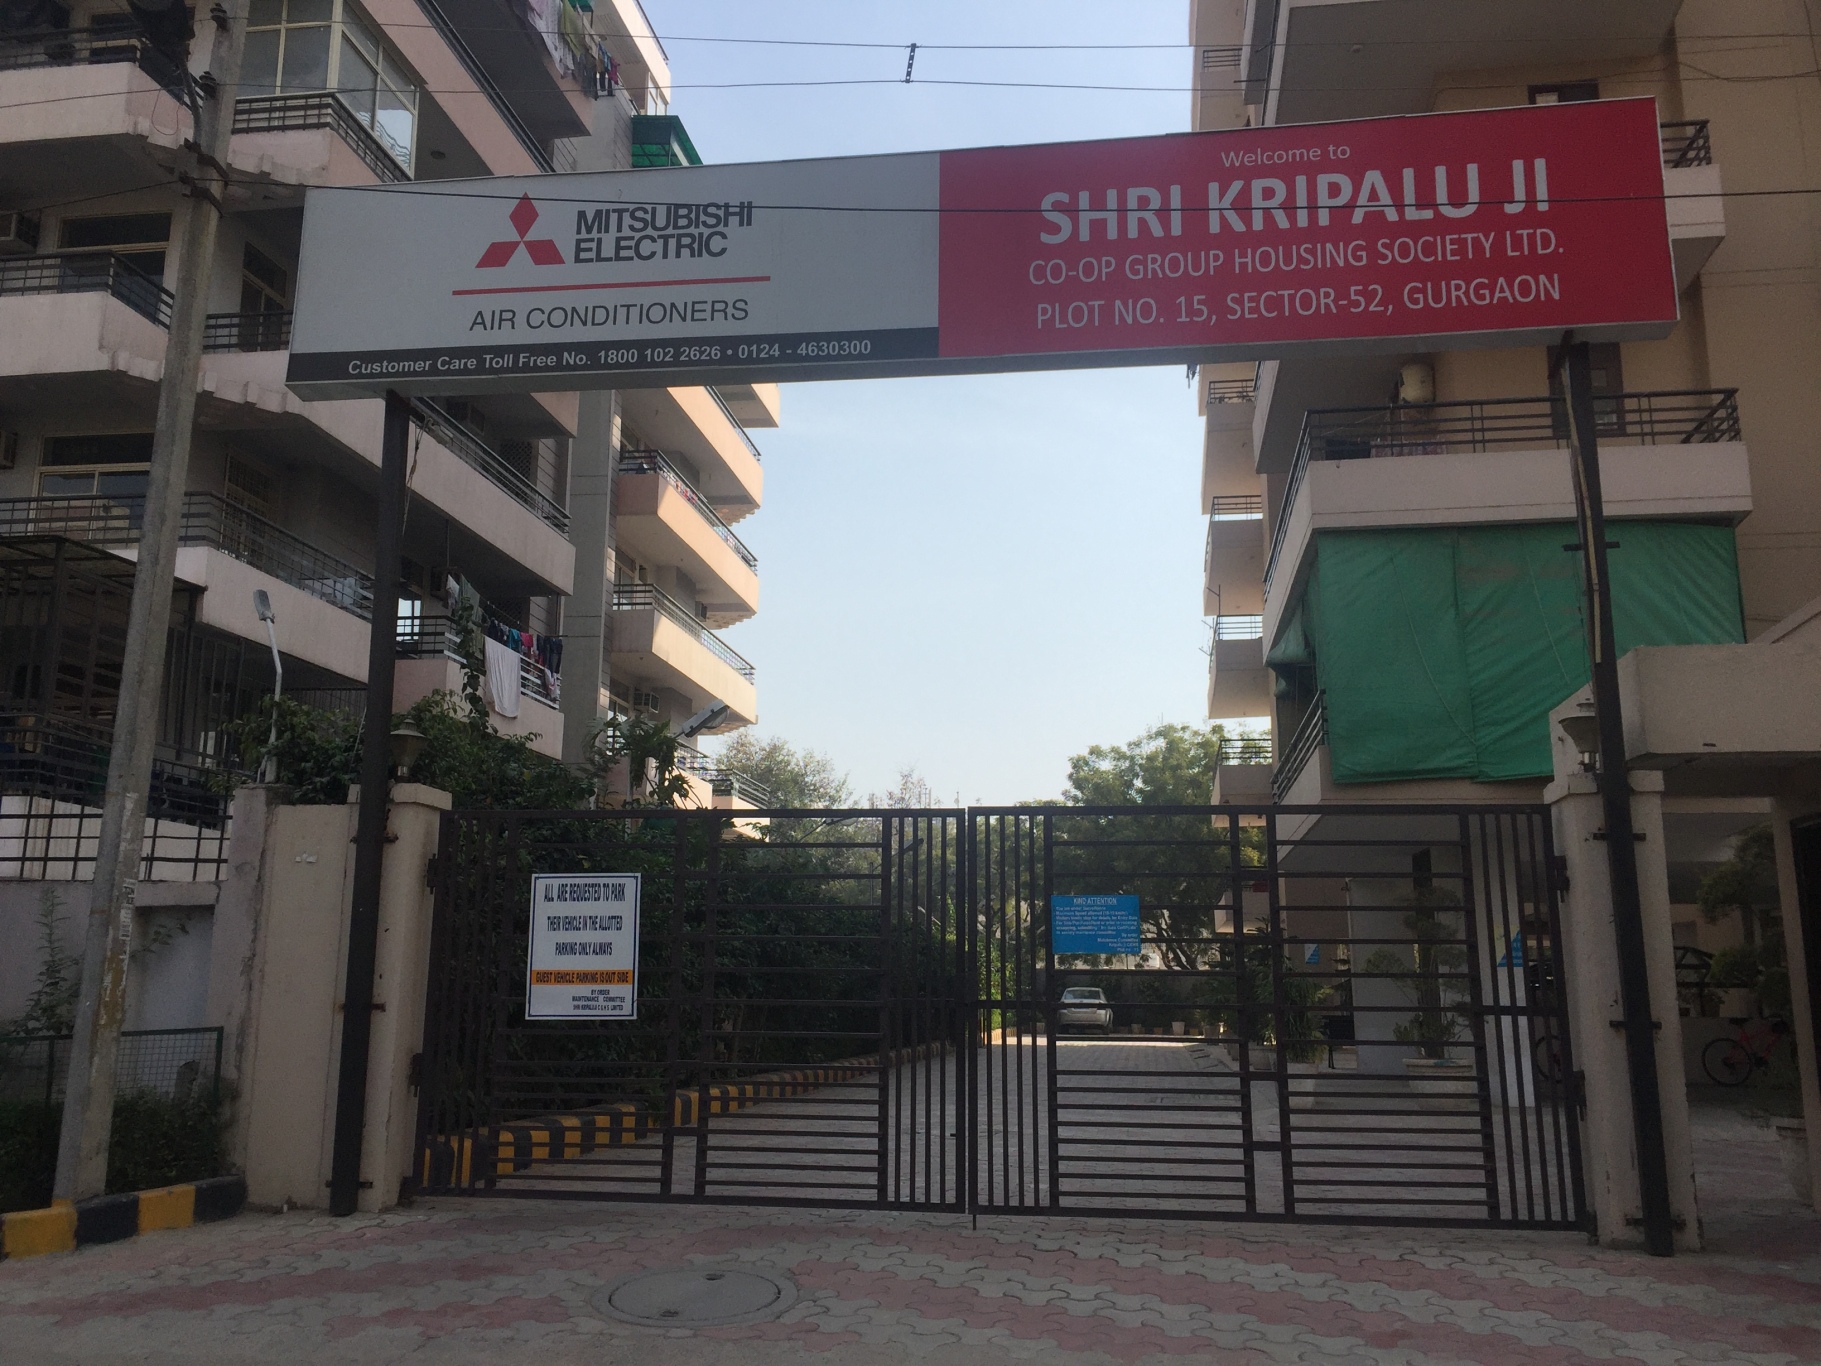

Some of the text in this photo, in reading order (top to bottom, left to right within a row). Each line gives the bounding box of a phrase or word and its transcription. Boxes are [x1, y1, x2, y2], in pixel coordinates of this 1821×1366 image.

[1220, 144, 1350, 168] Welcome to
[575, 200, 755, 235] MITSUBISHI
[1040, 157, 1549, 244] SHRI KRIPALU JI
[573, 231, 729, 265] ELECTRIC
[1029, 228, 1564, 285] CO-OP GROUP HOUSING SOCIETY LTD.
[469, 298, 749, 332] AIR CONDITIONERS
[1037, 273, 1560, 329] PLOT NO. 15, SECTOR-52, GURGAON
[348, 359, 433, 375] Customer
[437, 356, 477, 371] Care
[482, 353, 513, 369] Toll
[518, 353, 557, 367] Free
[562, 351, 591, 366] No.
[597, 348, 638, 364] 1800
[644, 347, 674, 362] 102
[679, 345, 721, 361] 2626
[738, 343, 781, 359] 0124
[796, 340, 871, 357] 4630300
[544, 882, 626, 902] ALL ARE REQUESTED TO PARK
[1087, 897, 1117, 905] ATTENTION
[547, 915, 623, 931] THEIR VEHICLE IN THE ALLOTTED
[555, 942, 613, 956] PARKING ONLY ALWAYS
[536, 972, 628, 983] GUEST VEHICLE PARKING IS OUT SIDE
